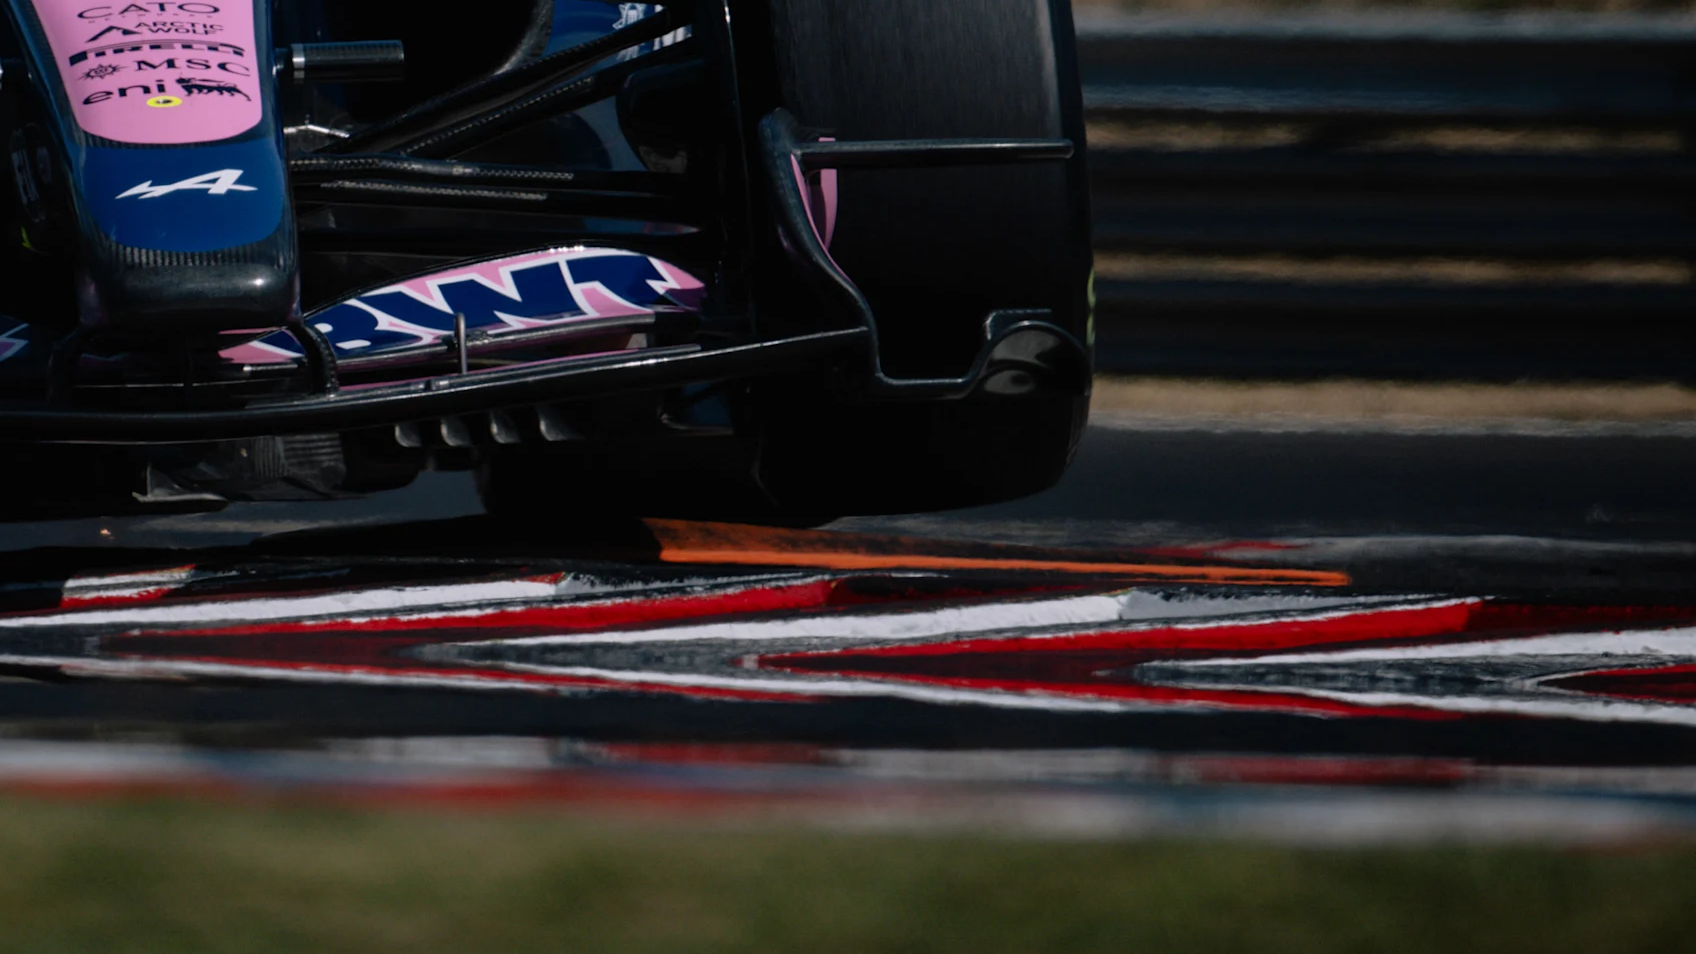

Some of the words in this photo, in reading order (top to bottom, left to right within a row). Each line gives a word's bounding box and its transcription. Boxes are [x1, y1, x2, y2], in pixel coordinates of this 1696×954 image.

[77, 2, 220, 20] CATO
[135, 21, 224, 31] ARCTIC
[148, 27, 218, 35] WOLF
[134, 58, 250, 77] MSC
[83, 80, 167, 105] eni
